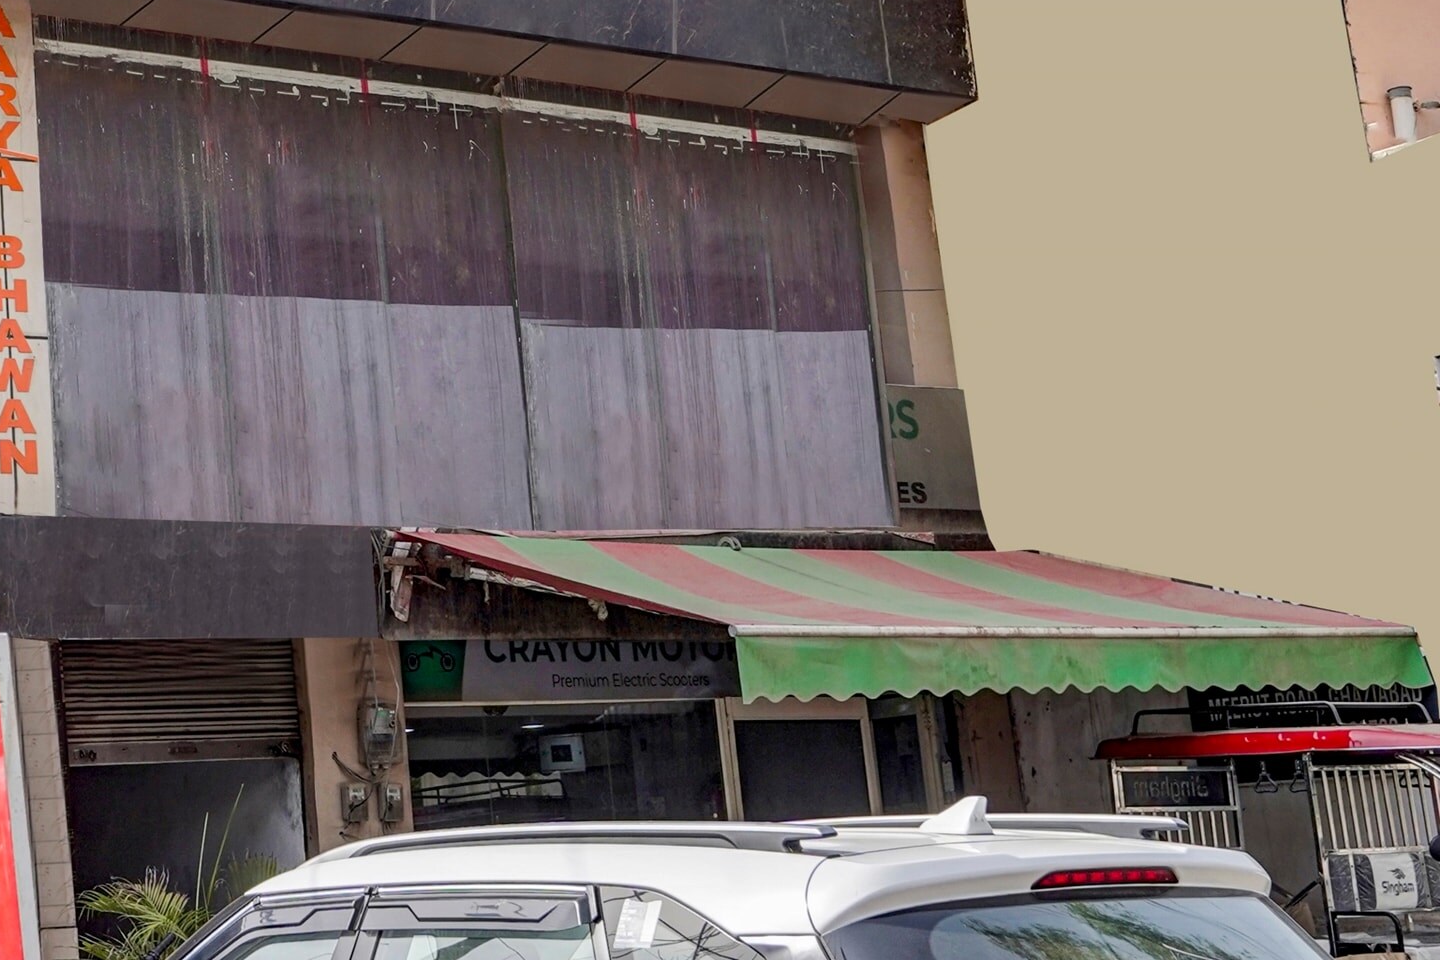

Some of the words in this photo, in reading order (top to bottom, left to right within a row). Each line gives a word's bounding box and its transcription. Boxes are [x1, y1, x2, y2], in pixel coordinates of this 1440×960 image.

[484, 640, 621, 663] CRAYON
[552, 673, 610, 688] Premium
[612, 672, 657, 687] Electric
[659, 672, 710, 687] Scooters
[1381, 880, 1415, 897] Singham
